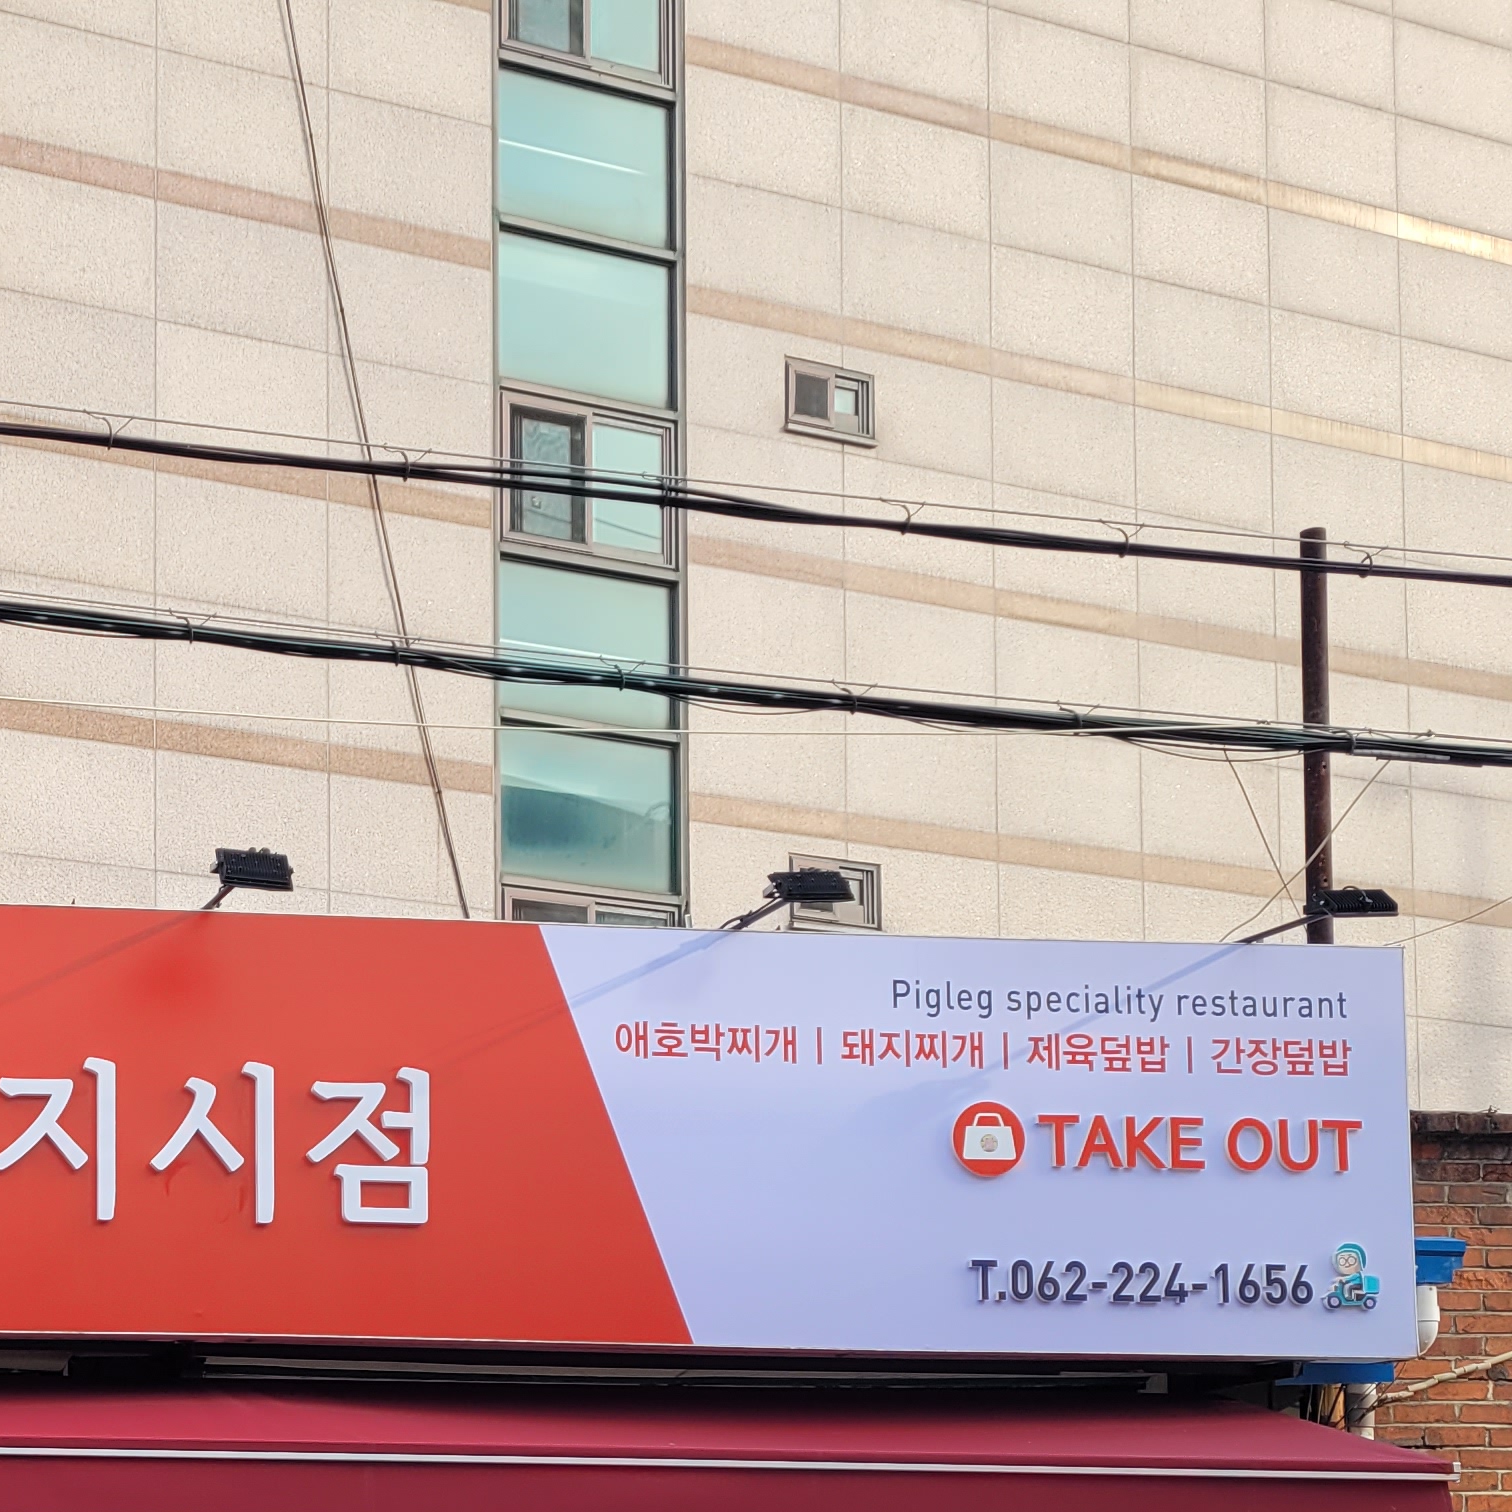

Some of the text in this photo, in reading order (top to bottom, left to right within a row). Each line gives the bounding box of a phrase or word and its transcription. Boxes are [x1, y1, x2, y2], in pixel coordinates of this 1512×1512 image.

[892, 979, 1348, 1022] Pigleg speciality restaurant
[614, 1020, 1353, 1077] 애호박찌개 돼지찌개 제육덮밥 간장덮밥
[1034, 1113, 1364, 1174] TAKE OUT
[968, 1258, 1315, 1308] T.062-224-1656
